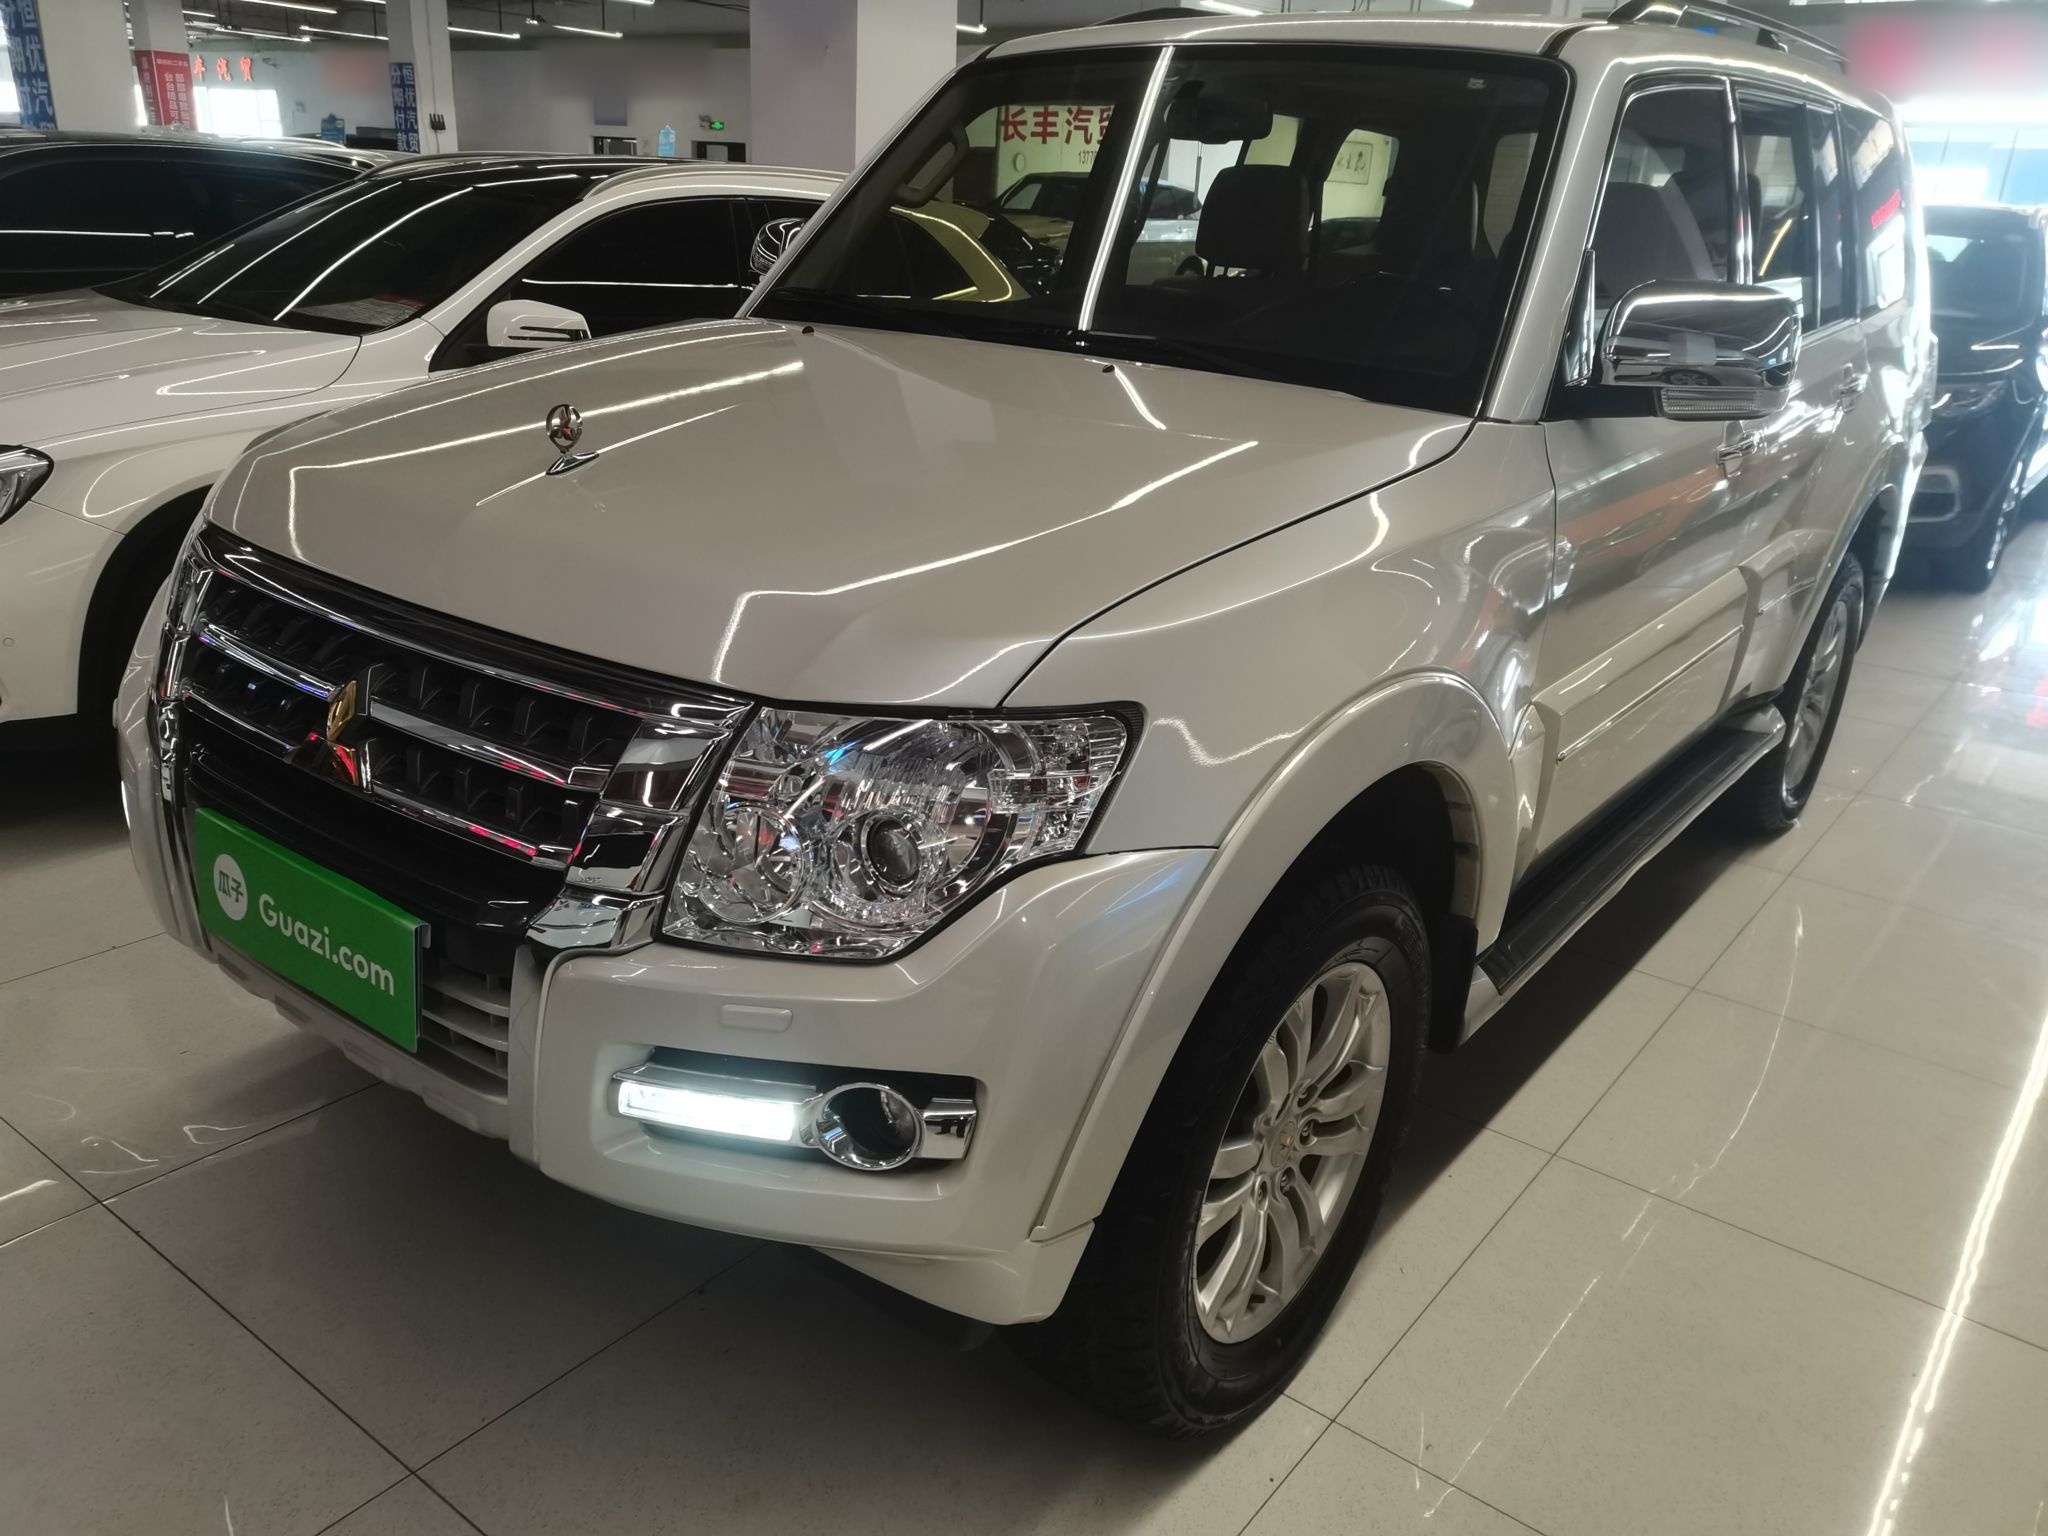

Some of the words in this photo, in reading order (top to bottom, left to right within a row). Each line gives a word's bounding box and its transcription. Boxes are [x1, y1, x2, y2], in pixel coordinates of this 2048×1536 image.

[0, 0, 38, 131] 分期付
[20, 0, 57, 131] 恒优汽
[1000, 105, 1111, 145] 长丰汽
[217, 869, 244, 903] 瓜子
[258, 893, 395, 996] Guazi.com
